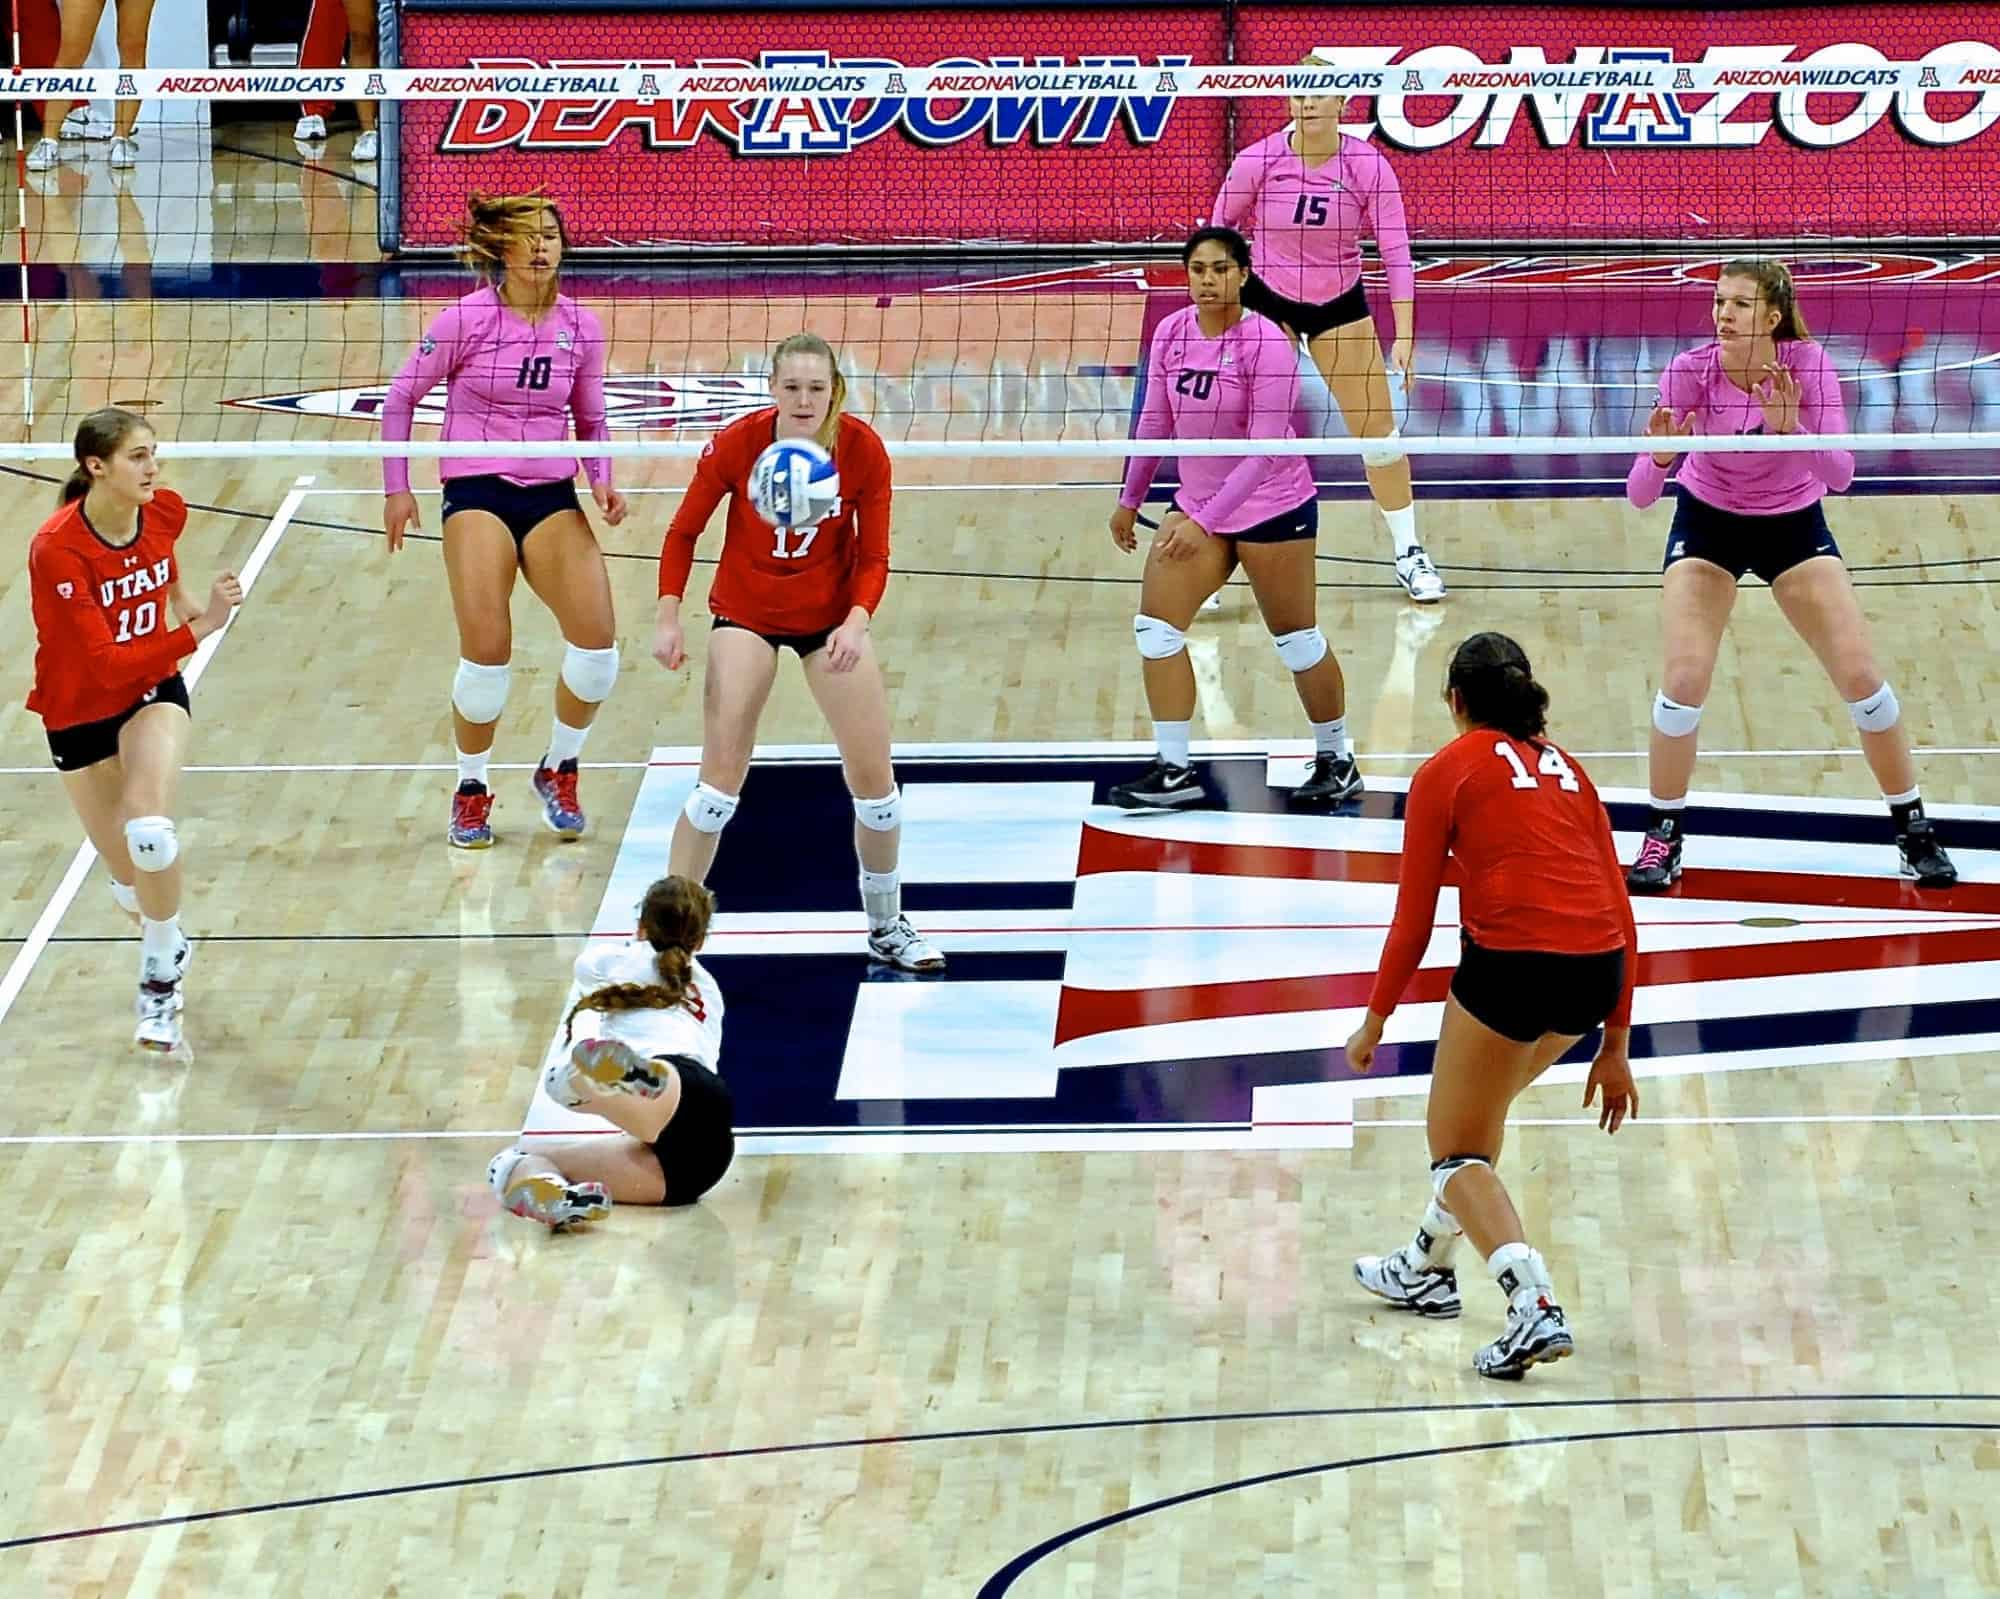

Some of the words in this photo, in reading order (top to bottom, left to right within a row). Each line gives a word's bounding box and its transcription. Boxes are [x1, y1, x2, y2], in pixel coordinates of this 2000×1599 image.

[1292, 194, 1330, 226] 15
[516, 356, 553, 391] 10
[1175, 368, 1219, 400] 20
[772, 526, 819, 558] 17
[101, 557, 170, 608] UTAH
[115, 601, 157, 643] 10
[1494, 741, 1580, 793] 14
